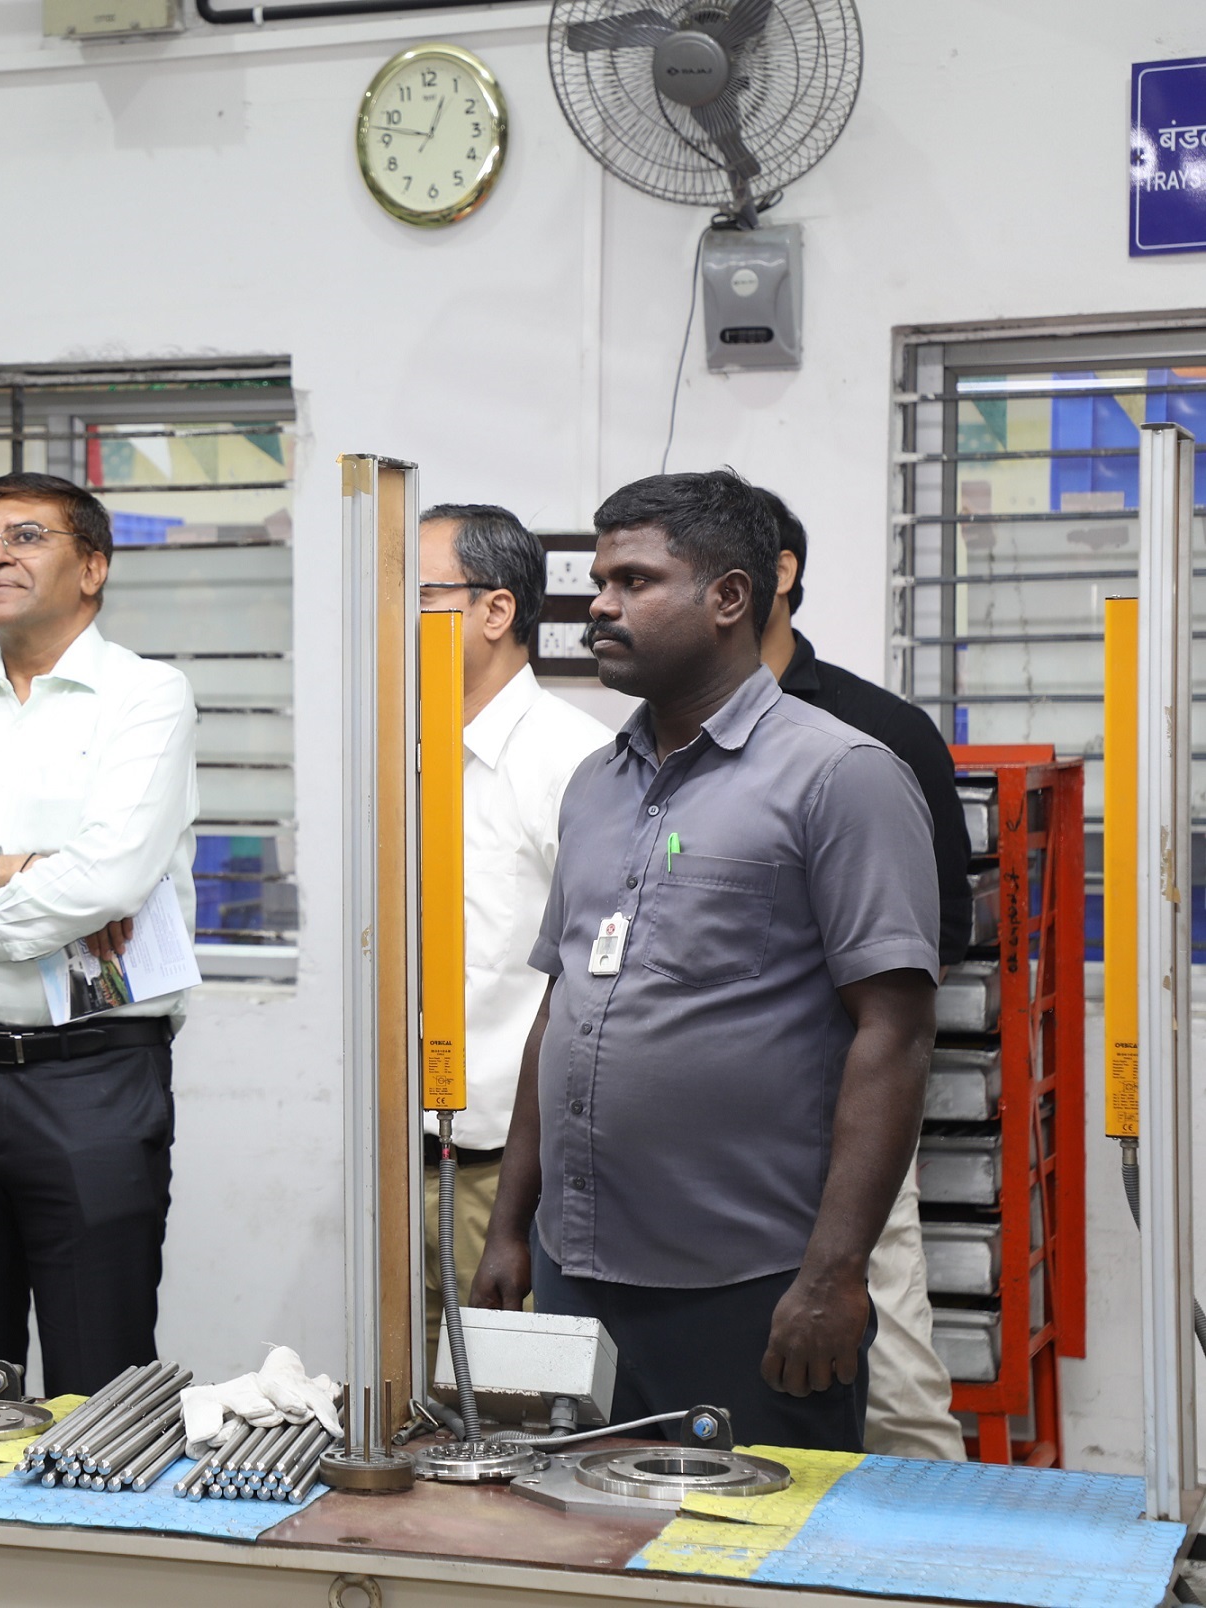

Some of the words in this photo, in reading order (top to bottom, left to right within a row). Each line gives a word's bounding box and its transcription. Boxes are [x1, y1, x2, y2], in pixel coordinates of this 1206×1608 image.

[421, 71, 438, 88] 12
[399, 86, 412, 102] 11
[465, 99, 476, 115] 2
[386, 109, 402, 125] 10
[472, 122, 482, 138] 3
[381, 133, 392, 148] 9
[466, 147, 477, 161] 4
[388, 157, 398, 172] 8
[402, 176, 413, 191] 7
[453, 170, 464, 187] 5
[428, 184, 439, 199] 6
